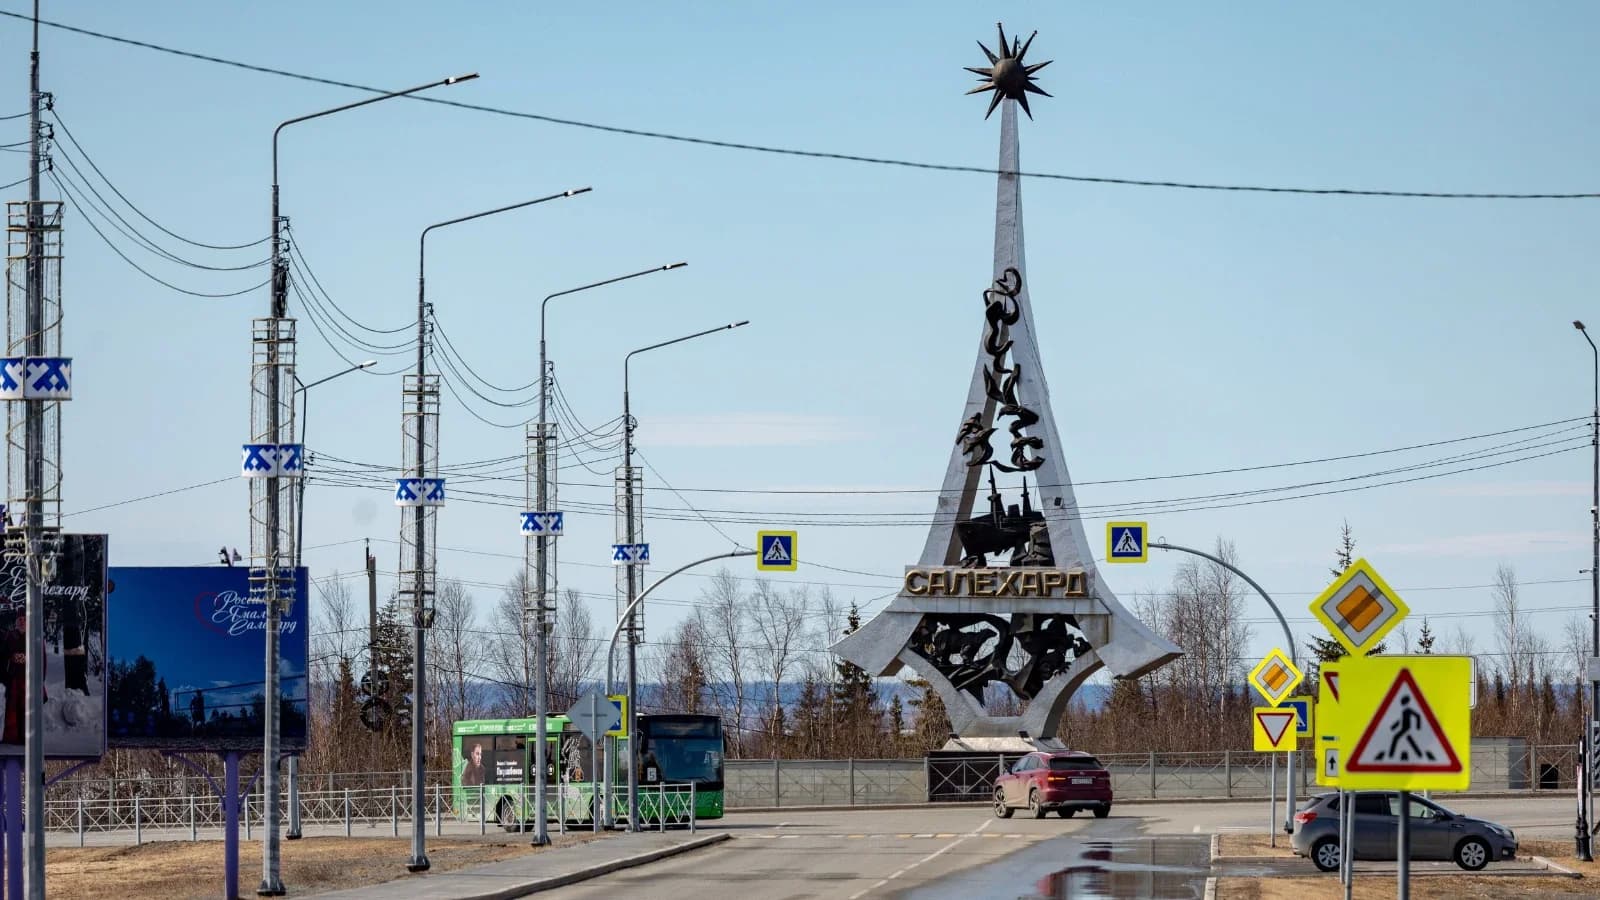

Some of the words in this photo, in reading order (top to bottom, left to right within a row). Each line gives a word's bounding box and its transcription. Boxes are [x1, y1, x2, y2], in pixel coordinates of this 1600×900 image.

[10, 582, 89, 602] Сехард
[905, 569, 1089, 597] САЛЕХАРД
[212, 605, 267, 623] Ямал
[228, 619, 297, 636] Салерд
